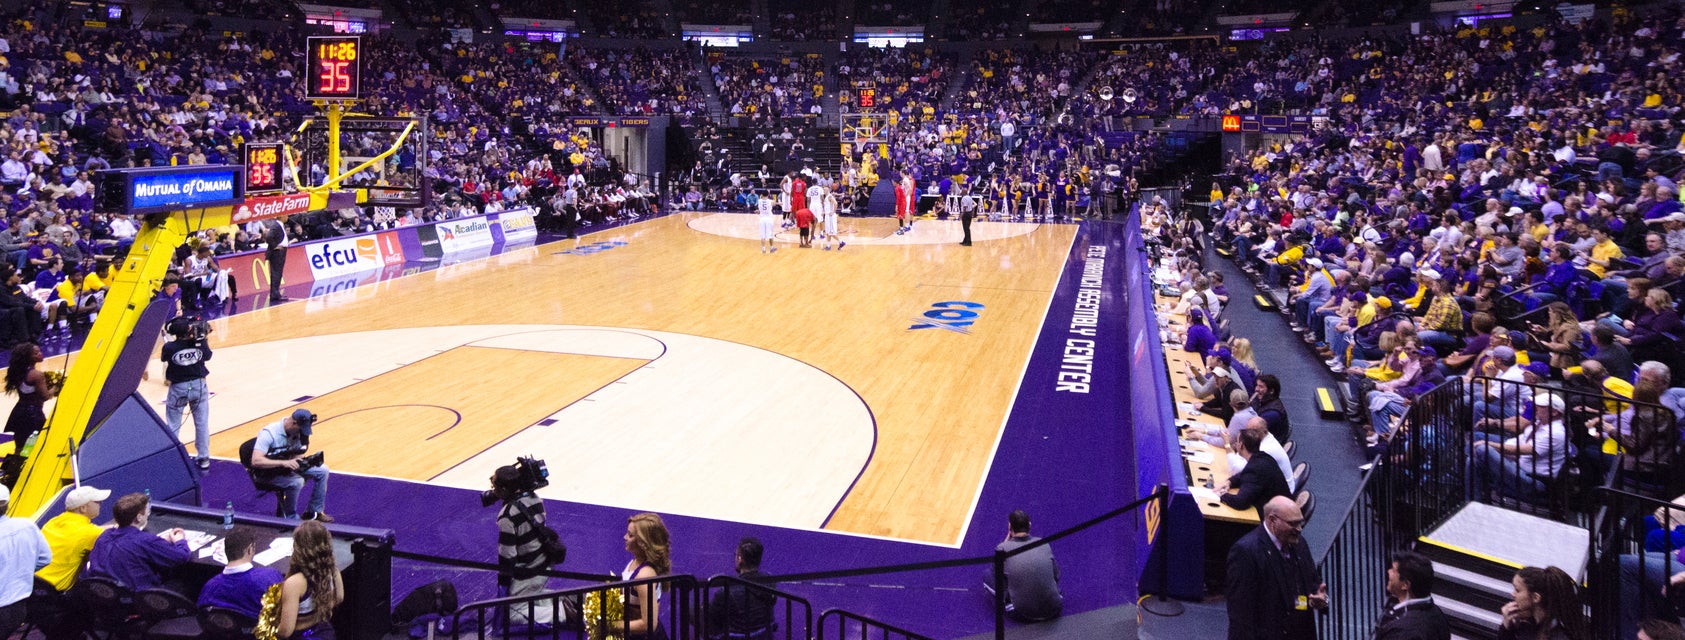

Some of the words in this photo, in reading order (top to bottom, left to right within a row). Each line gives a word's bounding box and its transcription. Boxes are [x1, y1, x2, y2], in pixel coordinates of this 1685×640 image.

[320, 43, 356, 60] 11:26
[320, 62, 350, 91] 35
[861, 95, 873, 106] 35
[251, 149, 277, 164] 11:26
[252, 165, 272, 185] 35
[135, 183, 180, 197] MUTUAL
[182, 180, 196, 196] of
[196, 180, 232, 192] OMAHA
[454, 221, 487, 235] Acadian
[311, 243, 358, 270] efcu
[179, 351, 197, 361] FOX
[1055, 338, 1095, 394] CENTER
